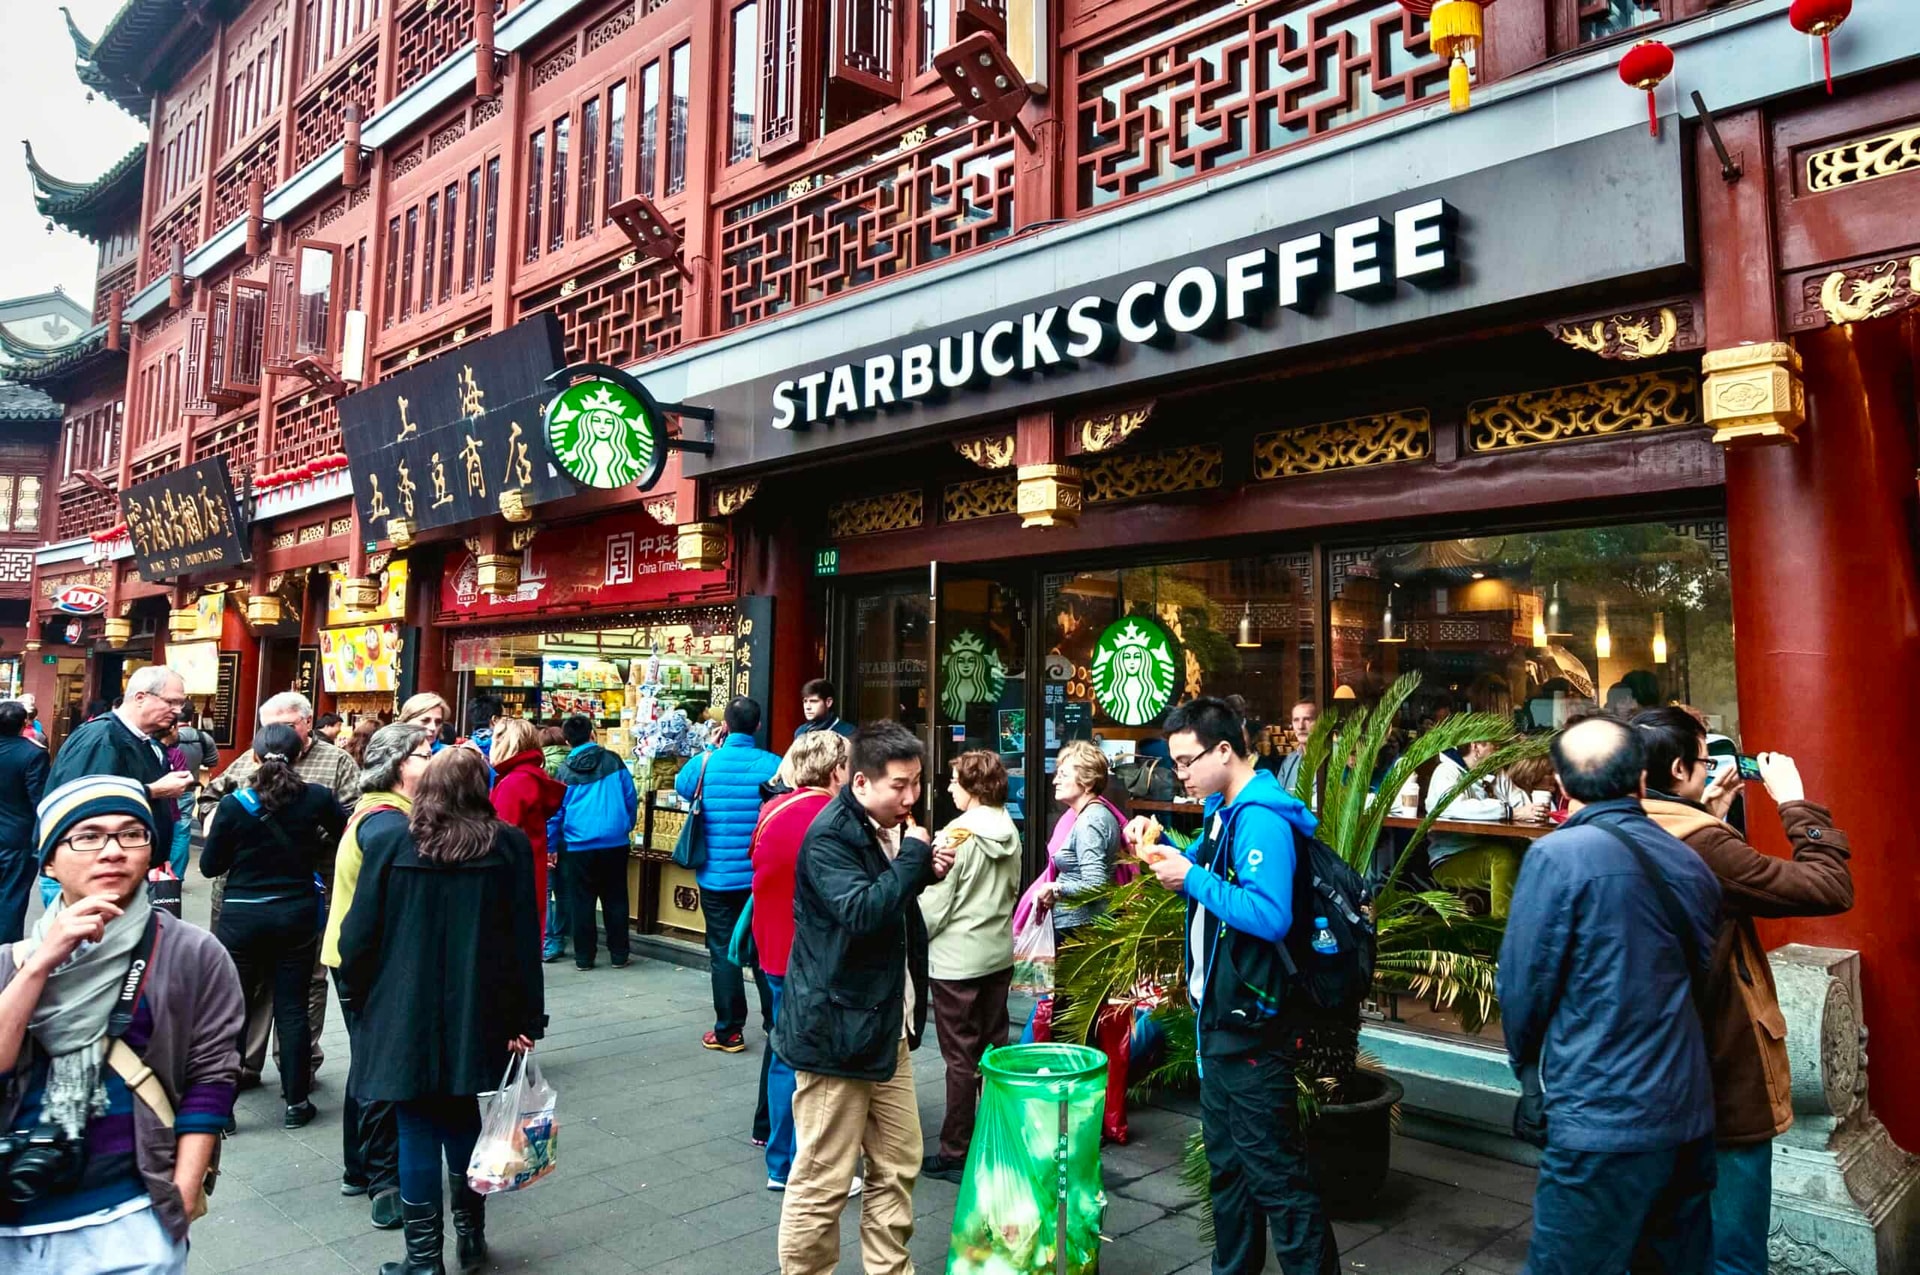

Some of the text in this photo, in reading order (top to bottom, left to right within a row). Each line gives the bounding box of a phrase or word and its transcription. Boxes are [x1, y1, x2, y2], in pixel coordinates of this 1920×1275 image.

[771, 198, 1447, 430] STARBUCKS COFFEE
[184, 547, 224, 567] DUMPLINGS
[817, 550, 836, 567] 100
[638, 561, 657, 575] China
[68, 590, 100, 607] DQ
[664, 633, 714, 657] 五香豆
[121, 959, 146, 1001] Canon
